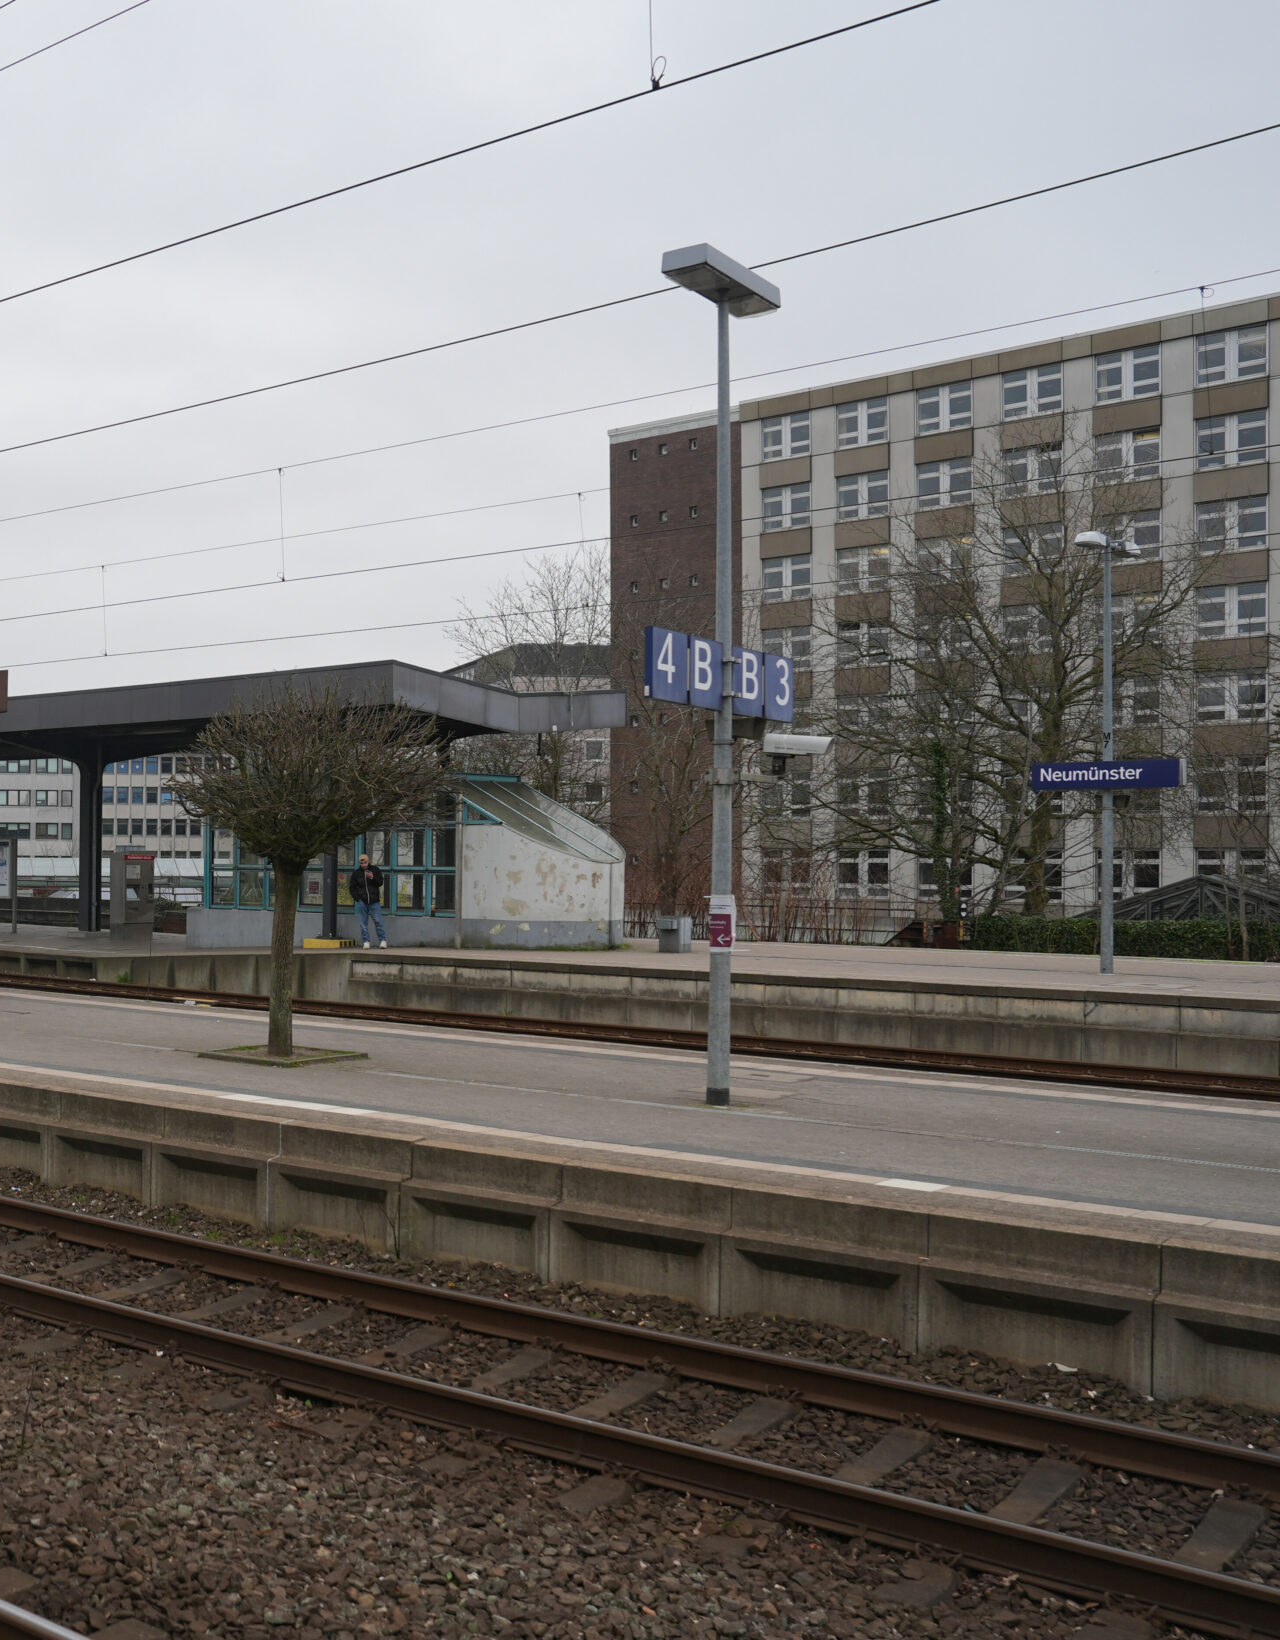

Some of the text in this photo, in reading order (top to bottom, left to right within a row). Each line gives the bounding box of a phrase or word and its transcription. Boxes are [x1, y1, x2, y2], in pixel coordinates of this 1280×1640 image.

[657, 632, 712, 691] 4 B
[742, 651, 790, 706] B 3
[1103, 732, 1111, 740] M
[1103, 740, 1110, 748] 7
[1040, 767, 1143, 782] Neumünster
